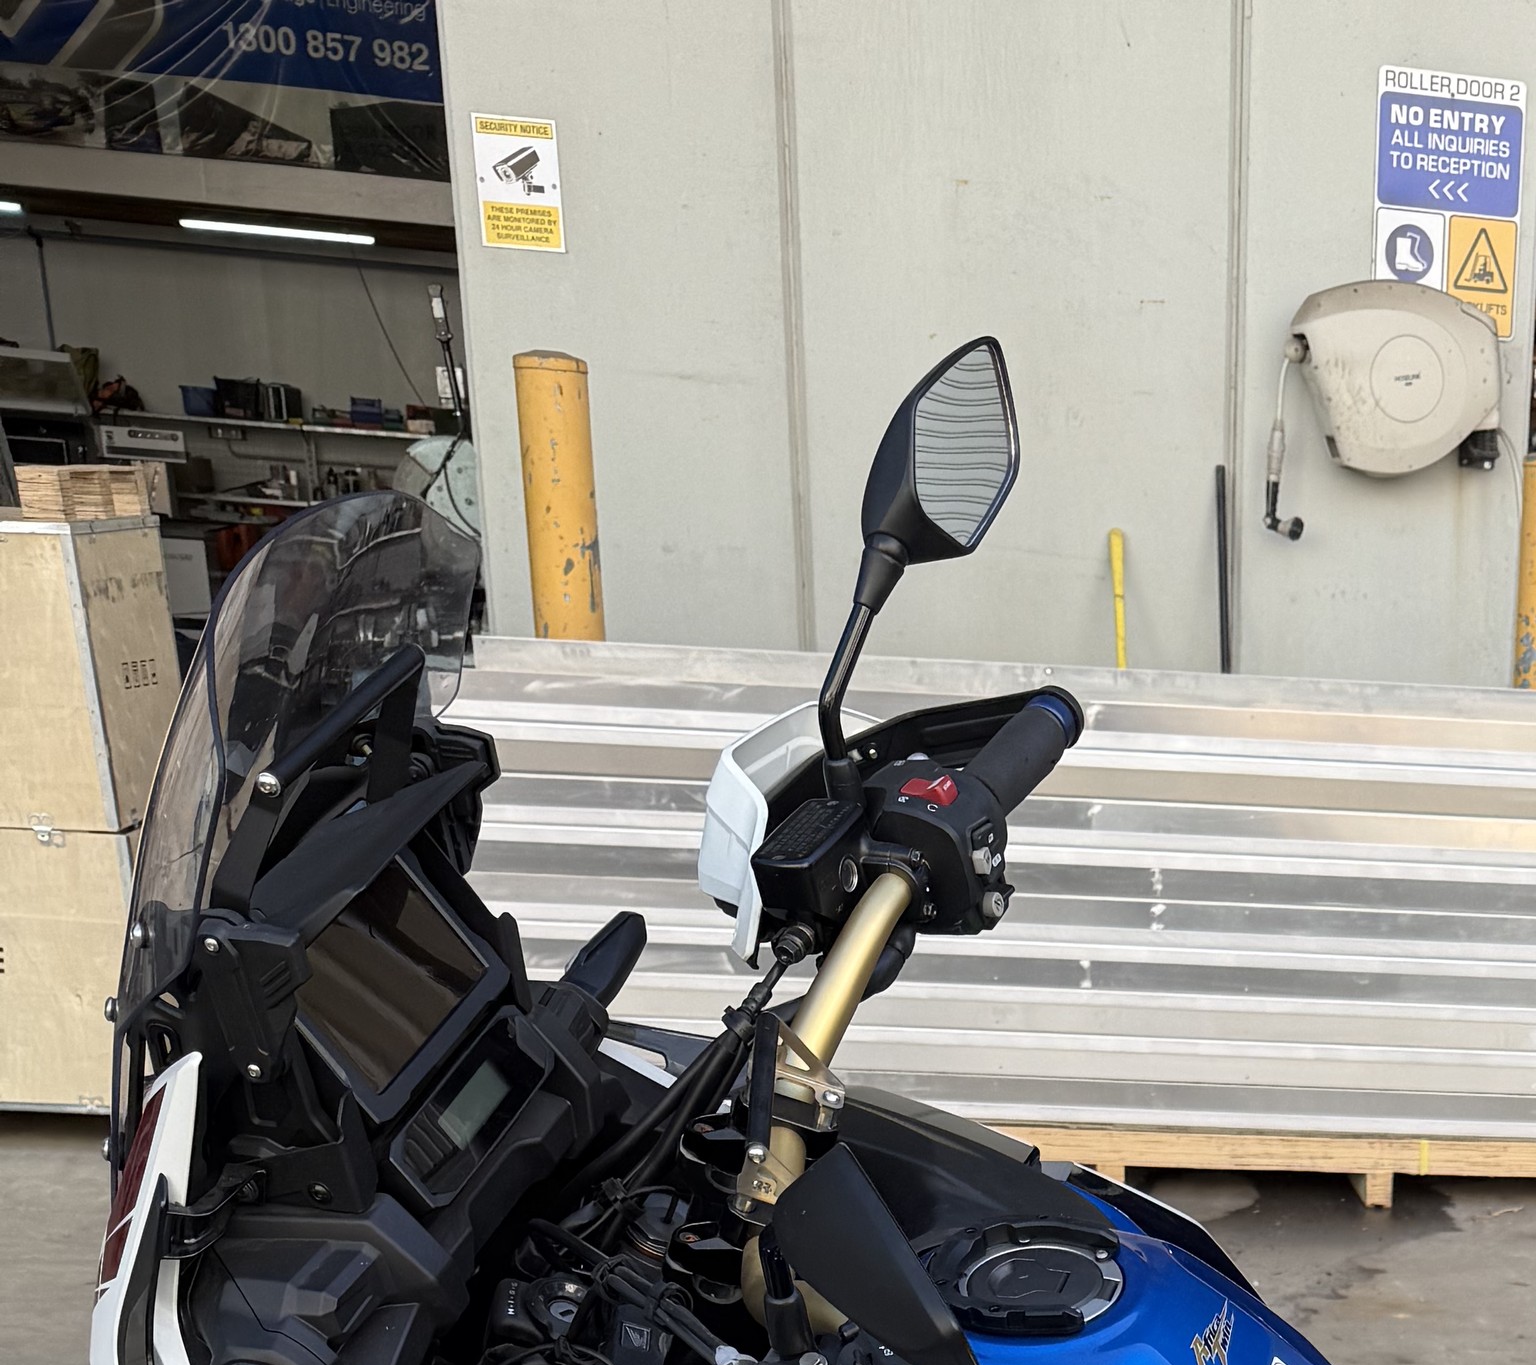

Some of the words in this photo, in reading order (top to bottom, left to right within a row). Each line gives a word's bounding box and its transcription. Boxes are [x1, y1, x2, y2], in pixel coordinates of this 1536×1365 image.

[222, 21, 296, 56] 1300
[306, 29, 362, 62] 857
[372, 38, 430, 71] 982
[1385, 69, 1451, 94] ROLLER
[1456, 78, 1505, 100] DOOR
[1509, 84, 1521, 101] 2
[479, 120, 519, 133] SECURITY
[519, 124, 550, 136] NOTICE
[1390, 104, 1424, 126] NO
[1429, 108, 1506, 135] ENTRY
[1391, 129, 1424, 149] ALL
[1428, 132, 1511, 158] INQUIRIES
[1389, 151, 1413, 169] TO
[1416, 154, 1511, 181] RECEPTION
[487, 214, 502, 223] ARE
[503, 216, 546, 226] MONITORED
[547, 219, 558, 227] BY
[491, 205, 515, 214] THESE
[516, 207, 552, 218] PREMISES
[491, 223, 500, 231] 24
[501, 224, 522, 233] HOUR
[523, 225, 554, 235] CAMERA
[496, 232, 551, 243] SURVEILLANCE
